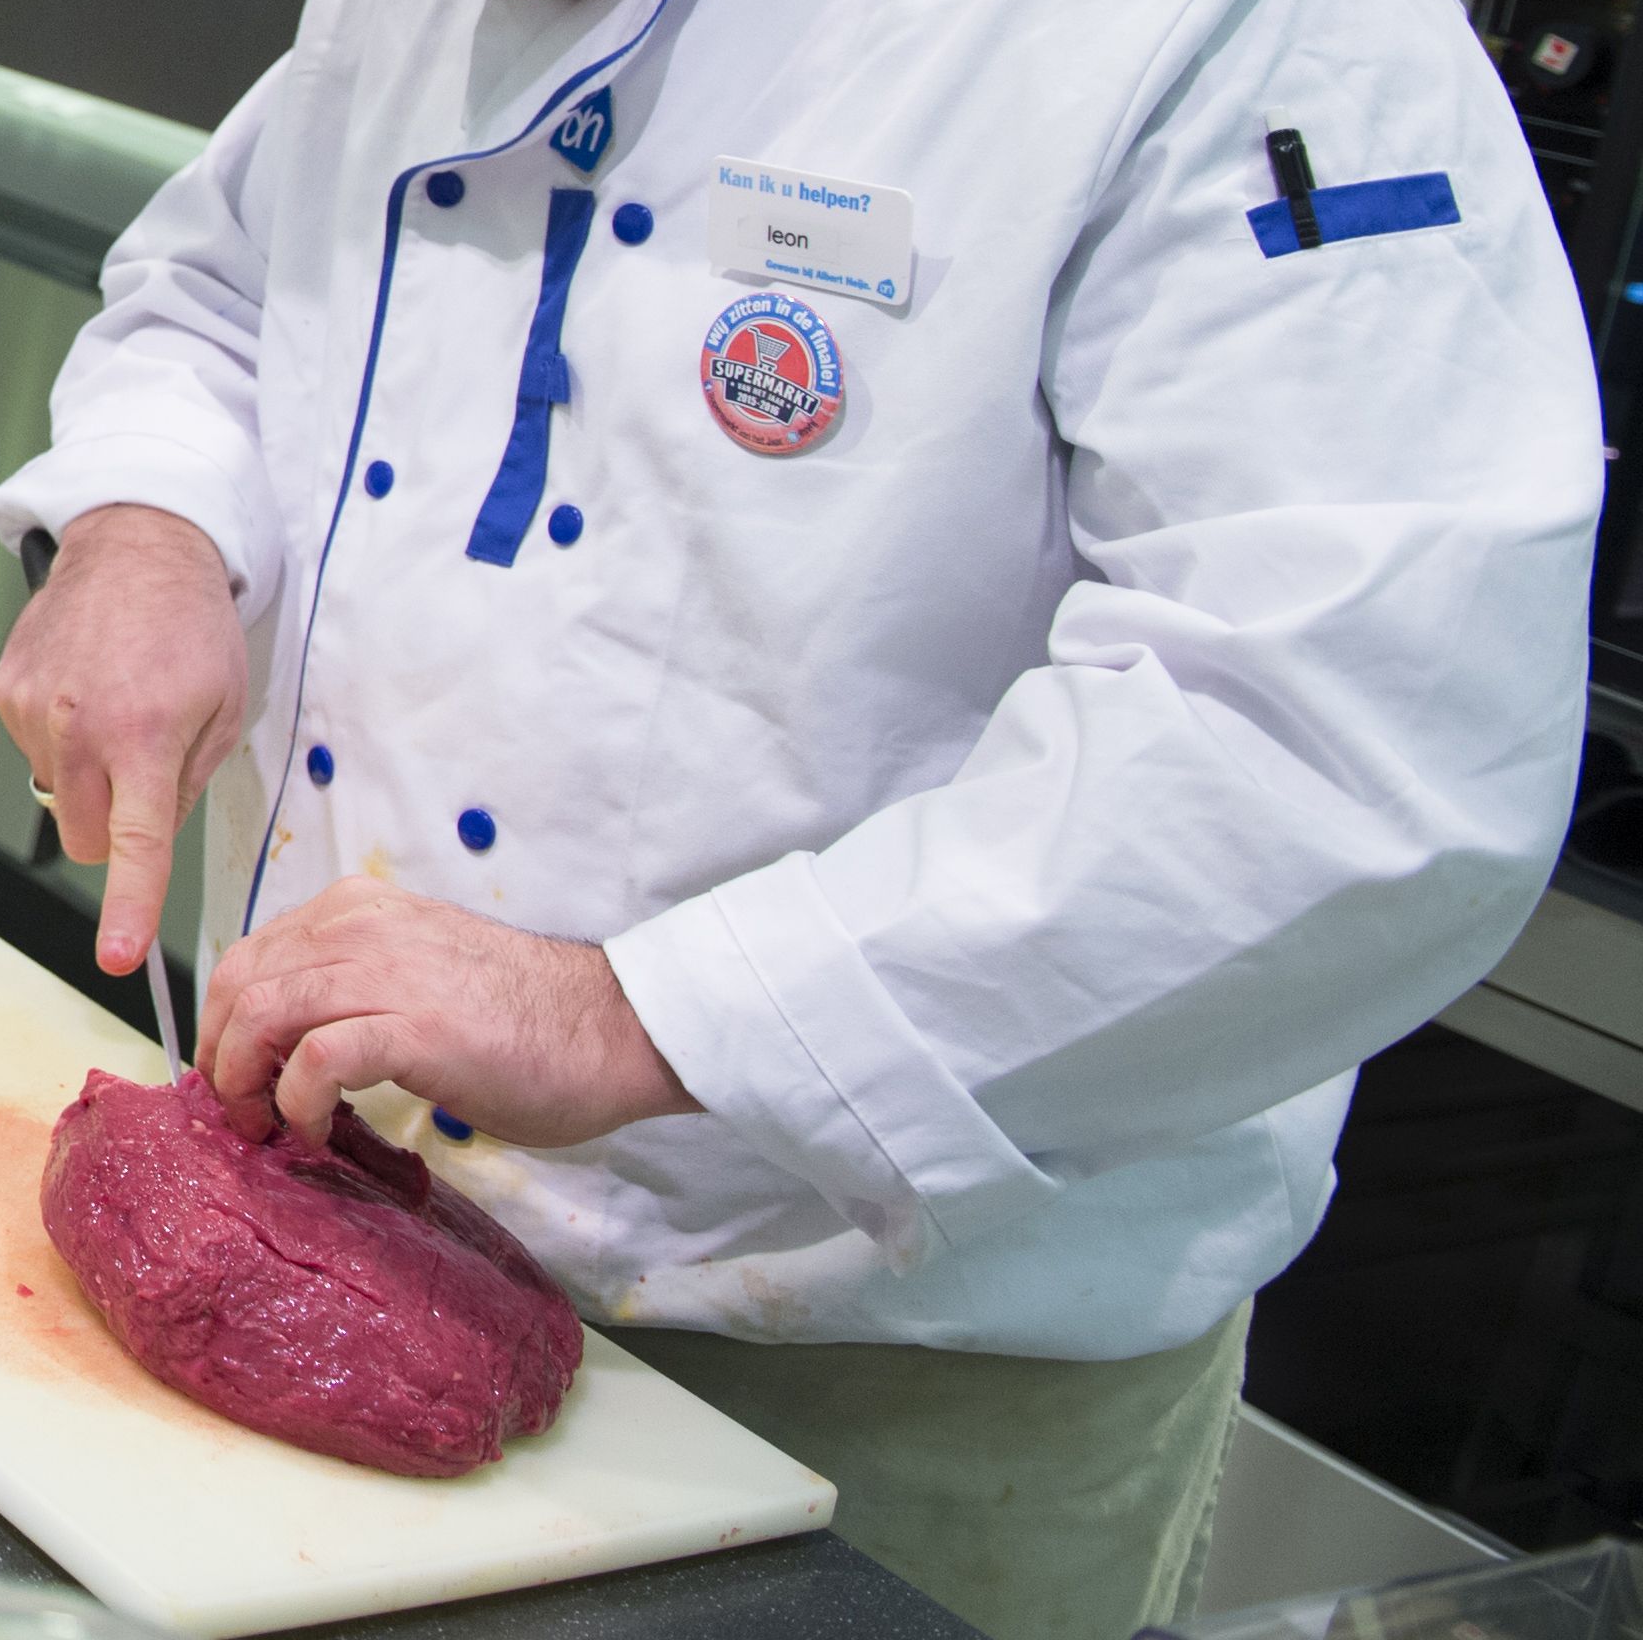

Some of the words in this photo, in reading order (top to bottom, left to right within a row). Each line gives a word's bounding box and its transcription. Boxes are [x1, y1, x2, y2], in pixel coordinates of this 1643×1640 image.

[719, 166, 753, 190] Kan
[759, 173, 776, 194] ik
[781, 183, 793, 197] u
[799, 182, 871, 213] helpen?
[767, 225, 809, 250] leon
[728, 299, 772, 326] zitten
[775, 299, 791, 317] in
[792, 310, 814, 331] de
[809, 327, 838, 388] finale!
[715, 361, 816, 412] SUPERMARKT
